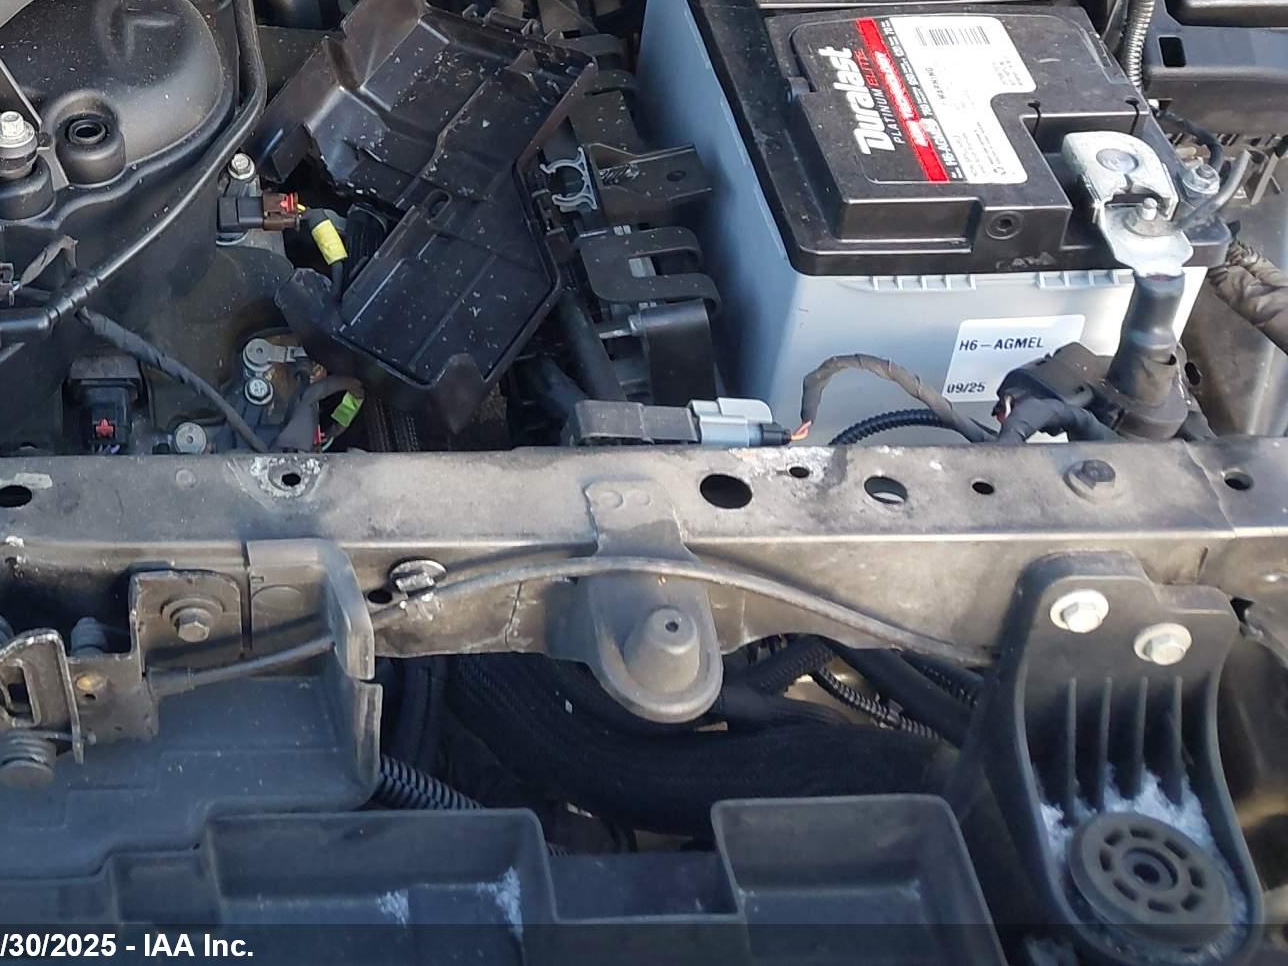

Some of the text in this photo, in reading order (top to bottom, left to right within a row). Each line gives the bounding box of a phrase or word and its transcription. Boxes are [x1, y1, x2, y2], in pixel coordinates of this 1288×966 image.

[854, 48, 879, 87] ELITE
[818, 46, 895, 155] Duralast
[872, 88, 906, 145] PLATINUM
[959, 339, 978, 351] H6
[993, 337, 1044, 350] AGMEL
[946, 381, 986, 394] 09/25
